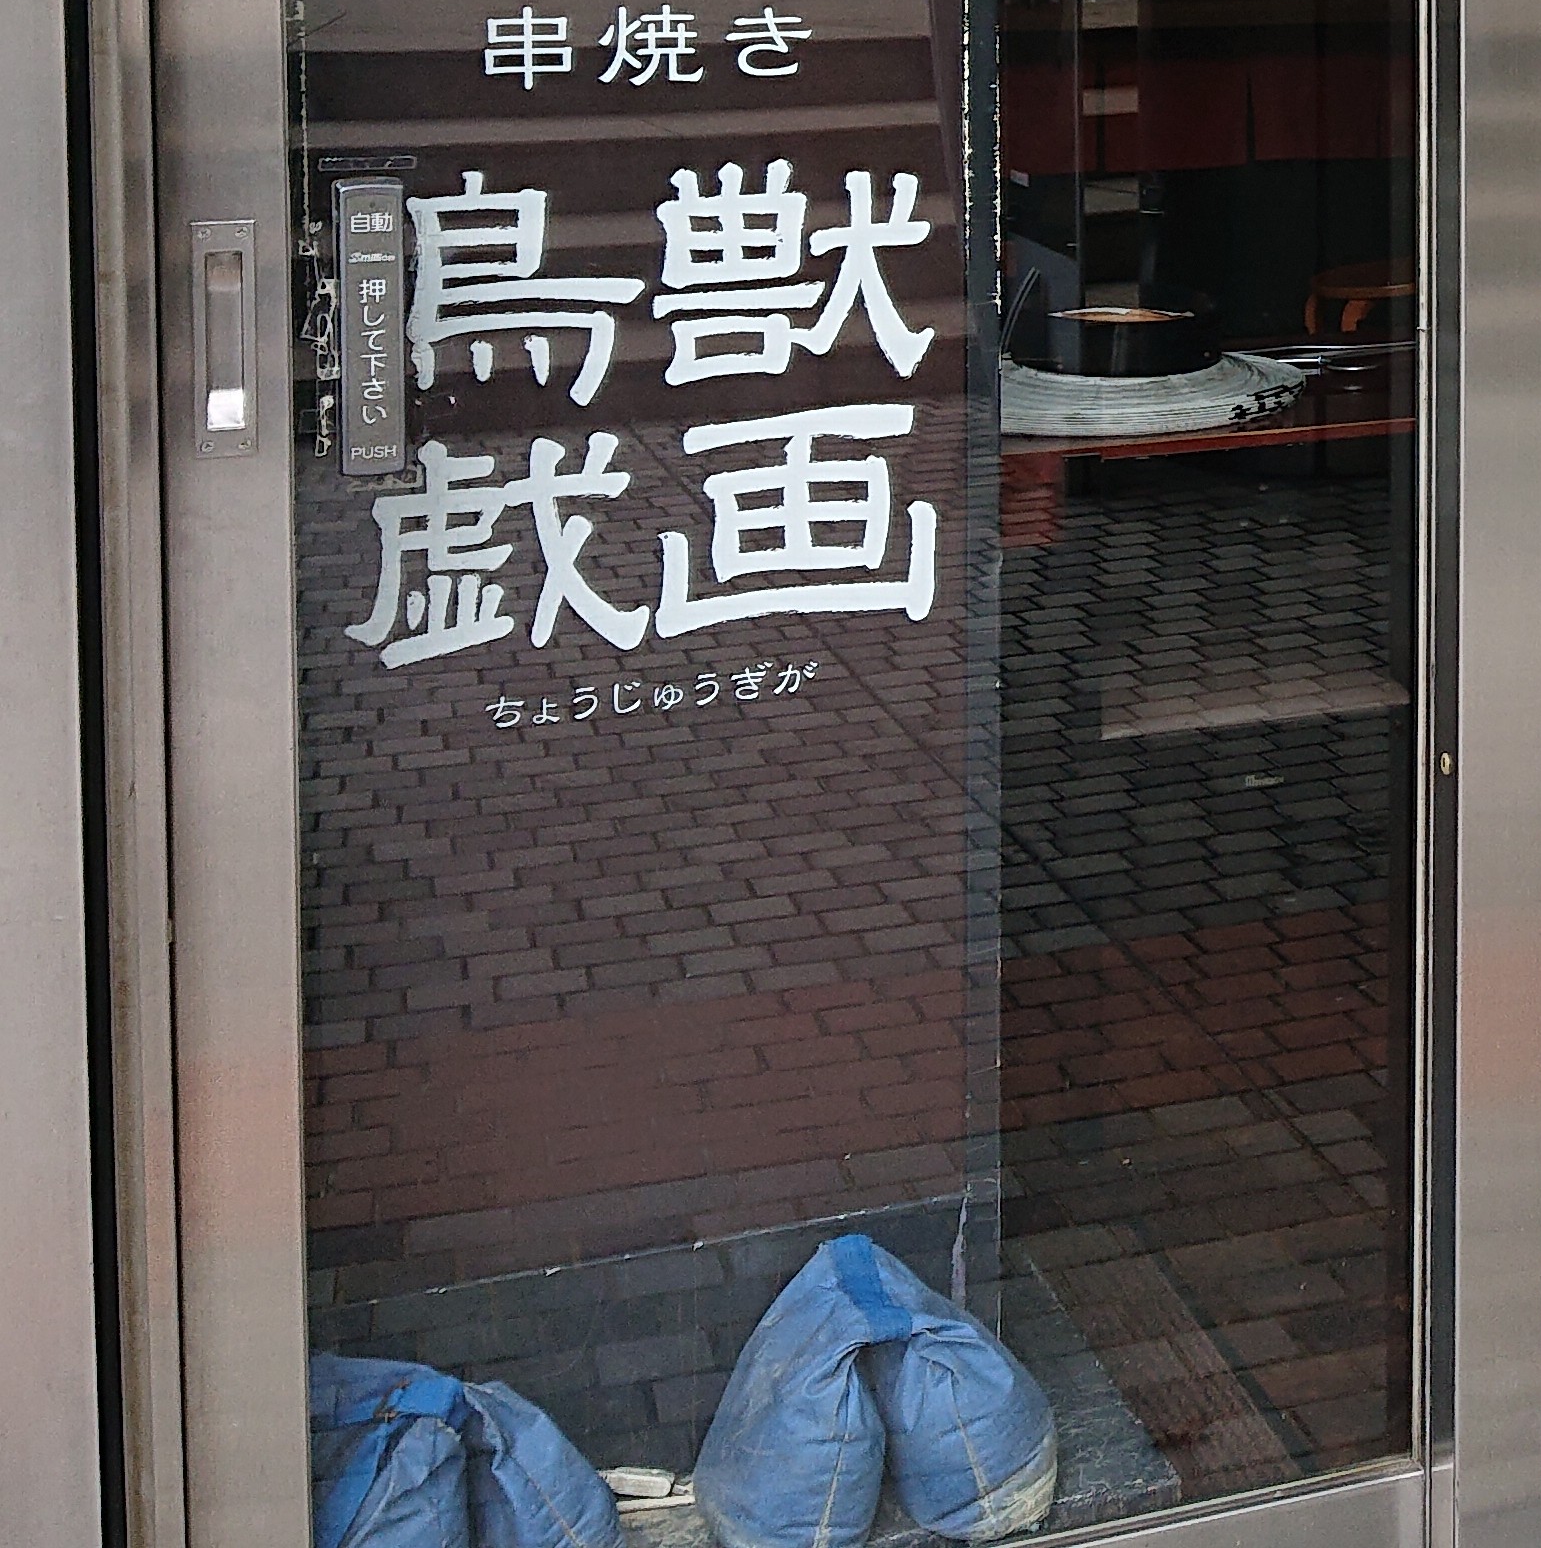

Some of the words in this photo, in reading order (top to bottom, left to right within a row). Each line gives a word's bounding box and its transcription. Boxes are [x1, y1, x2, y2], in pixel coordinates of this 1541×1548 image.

[484, 4, 813, 91] 串焼き
[349, 212, 394, 234] 自動
[405, 159, 935, 407] 鳥獣
[358, 278, 389, 424] 押して下さい
[350, 444, 398, 461] PUSH
[343, 403, 937, 671] 戯画
[485, 660, 819, 728] ちょうじゅうぎが
